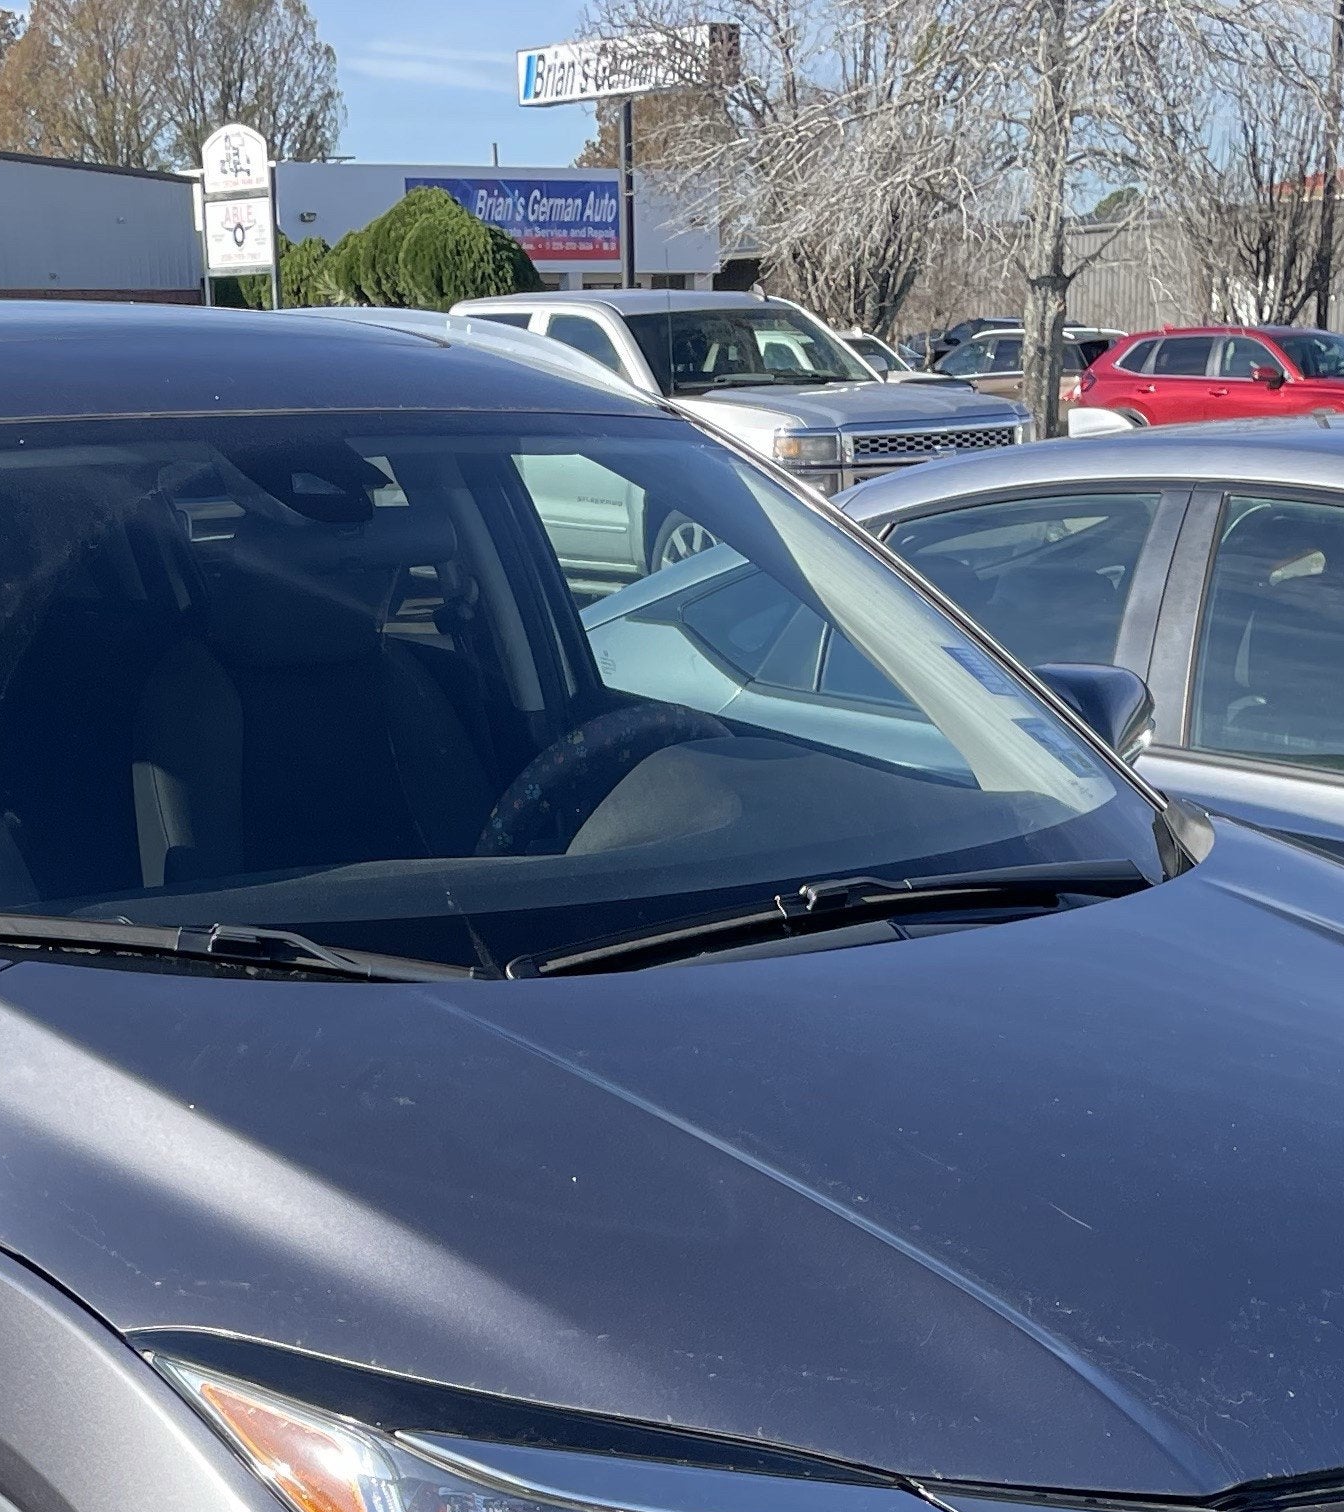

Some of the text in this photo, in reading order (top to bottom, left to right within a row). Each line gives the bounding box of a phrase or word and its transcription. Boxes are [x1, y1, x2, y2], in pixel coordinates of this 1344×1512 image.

[224, 204, 254, 223] ABLE
[475, 188, 617, 223] Brian's German Auto
